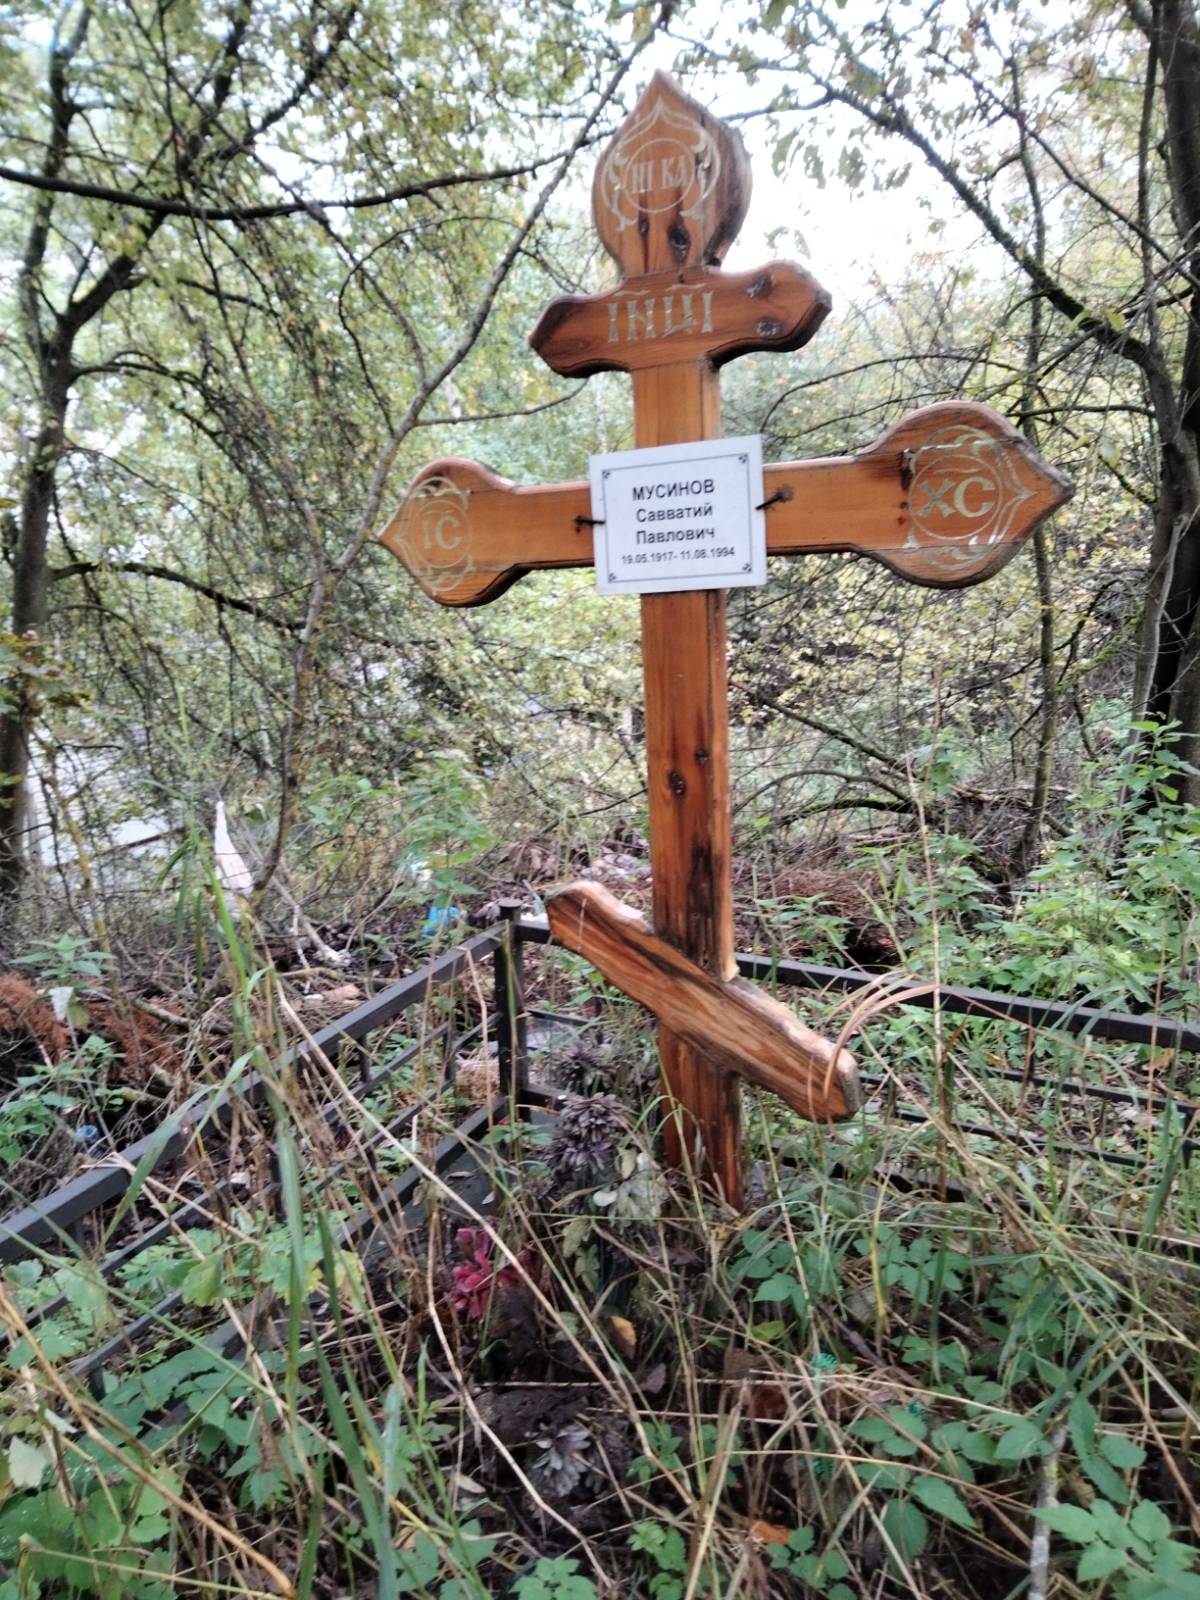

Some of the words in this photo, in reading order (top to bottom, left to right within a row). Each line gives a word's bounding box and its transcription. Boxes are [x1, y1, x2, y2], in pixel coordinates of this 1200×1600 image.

[632, 478, 716, 501] МУСИНОВ
[636, 502, 714, 523] Савватий
[635, 527, 716, 545] Павлович
